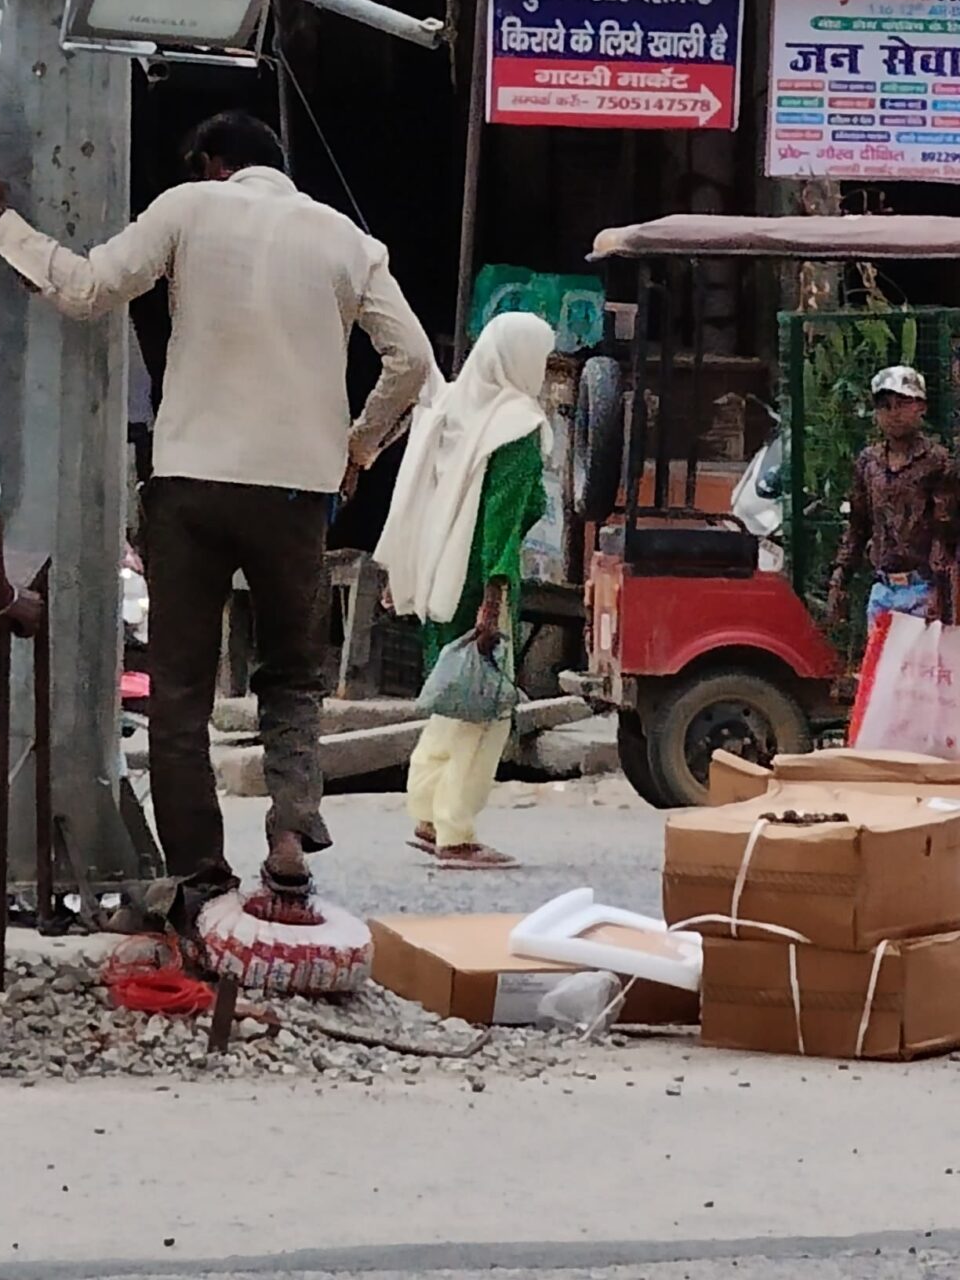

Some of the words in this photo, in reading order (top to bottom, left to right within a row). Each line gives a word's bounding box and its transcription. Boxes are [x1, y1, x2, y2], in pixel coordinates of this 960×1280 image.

[500, 16, 566, 54] किराये
[570, 19, 595, 54] के
[599, 20, 644, 57] लिये
[647, 22, 704, 60] खाली
[709, 23, 729, 61] है
[785, 42, 864, 74] जन
[879, 35, 960, 77] सेवा
[534, 65, 612, 88] गायत्री
[596, 95, 712, 112] 7505147578
